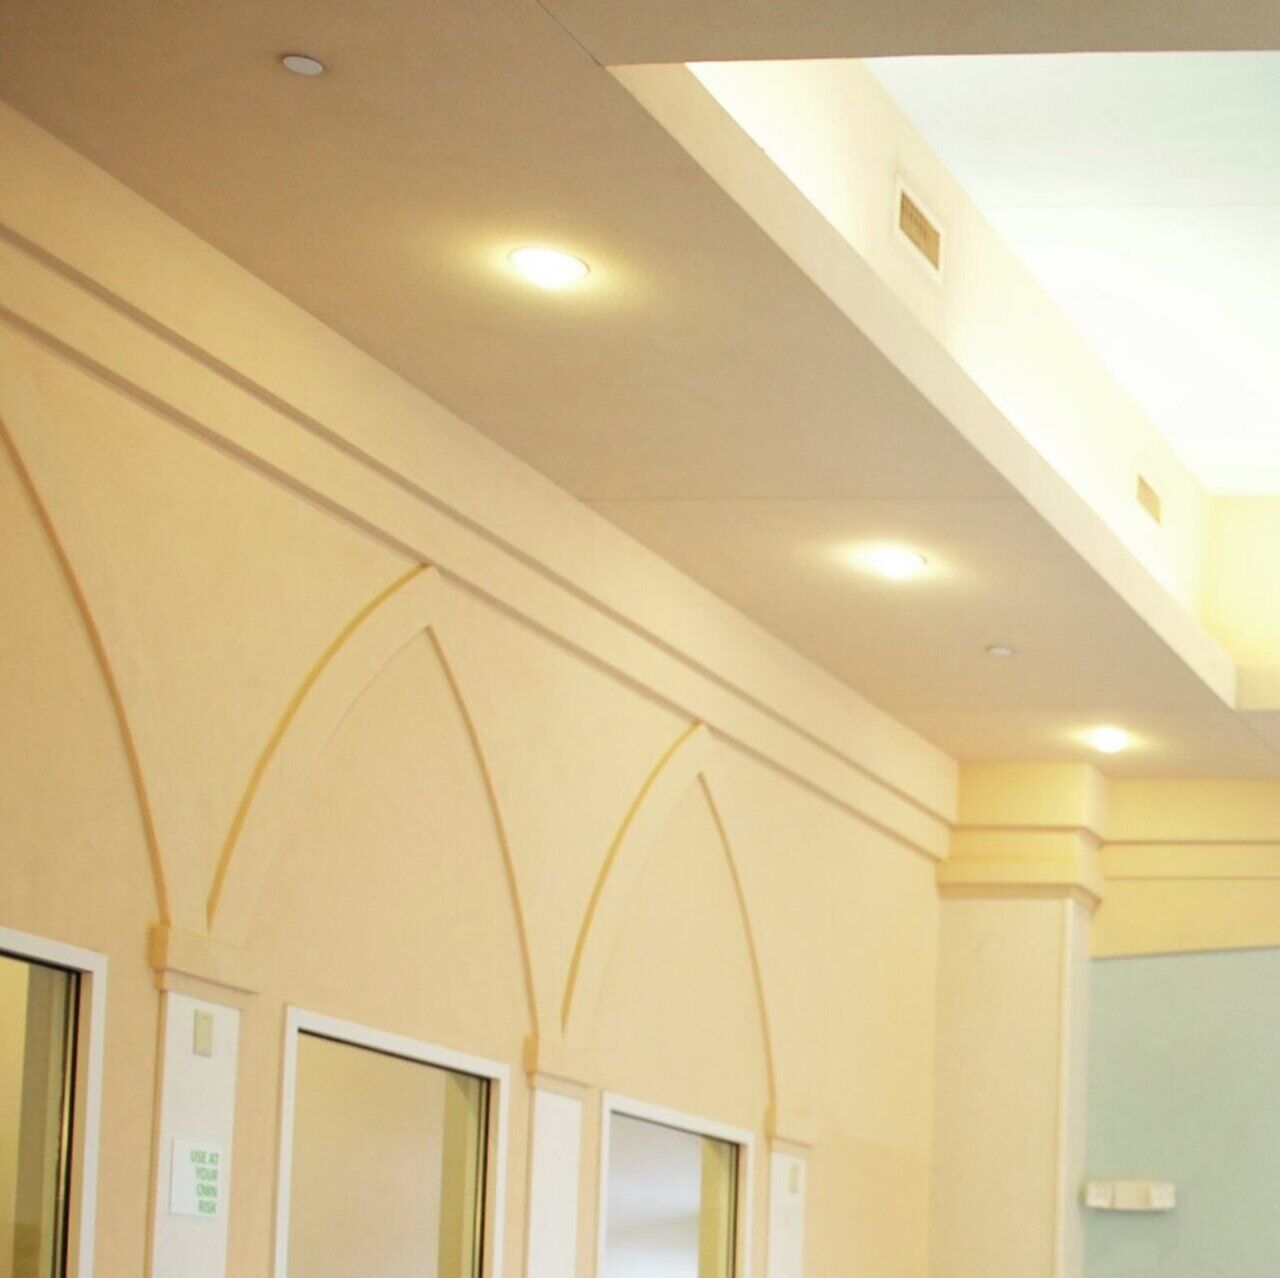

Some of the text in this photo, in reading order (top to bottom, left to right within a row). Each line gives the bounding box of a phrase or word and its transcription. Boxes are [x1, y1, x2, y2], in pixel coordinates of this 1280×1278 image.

[191, 1148, 219, 1166] USE AT
[195, 1166, 218, 1181] YOUR
[196, 1183, 218, 1198] OWN
[198, 1200, 217, 1214] RISK
